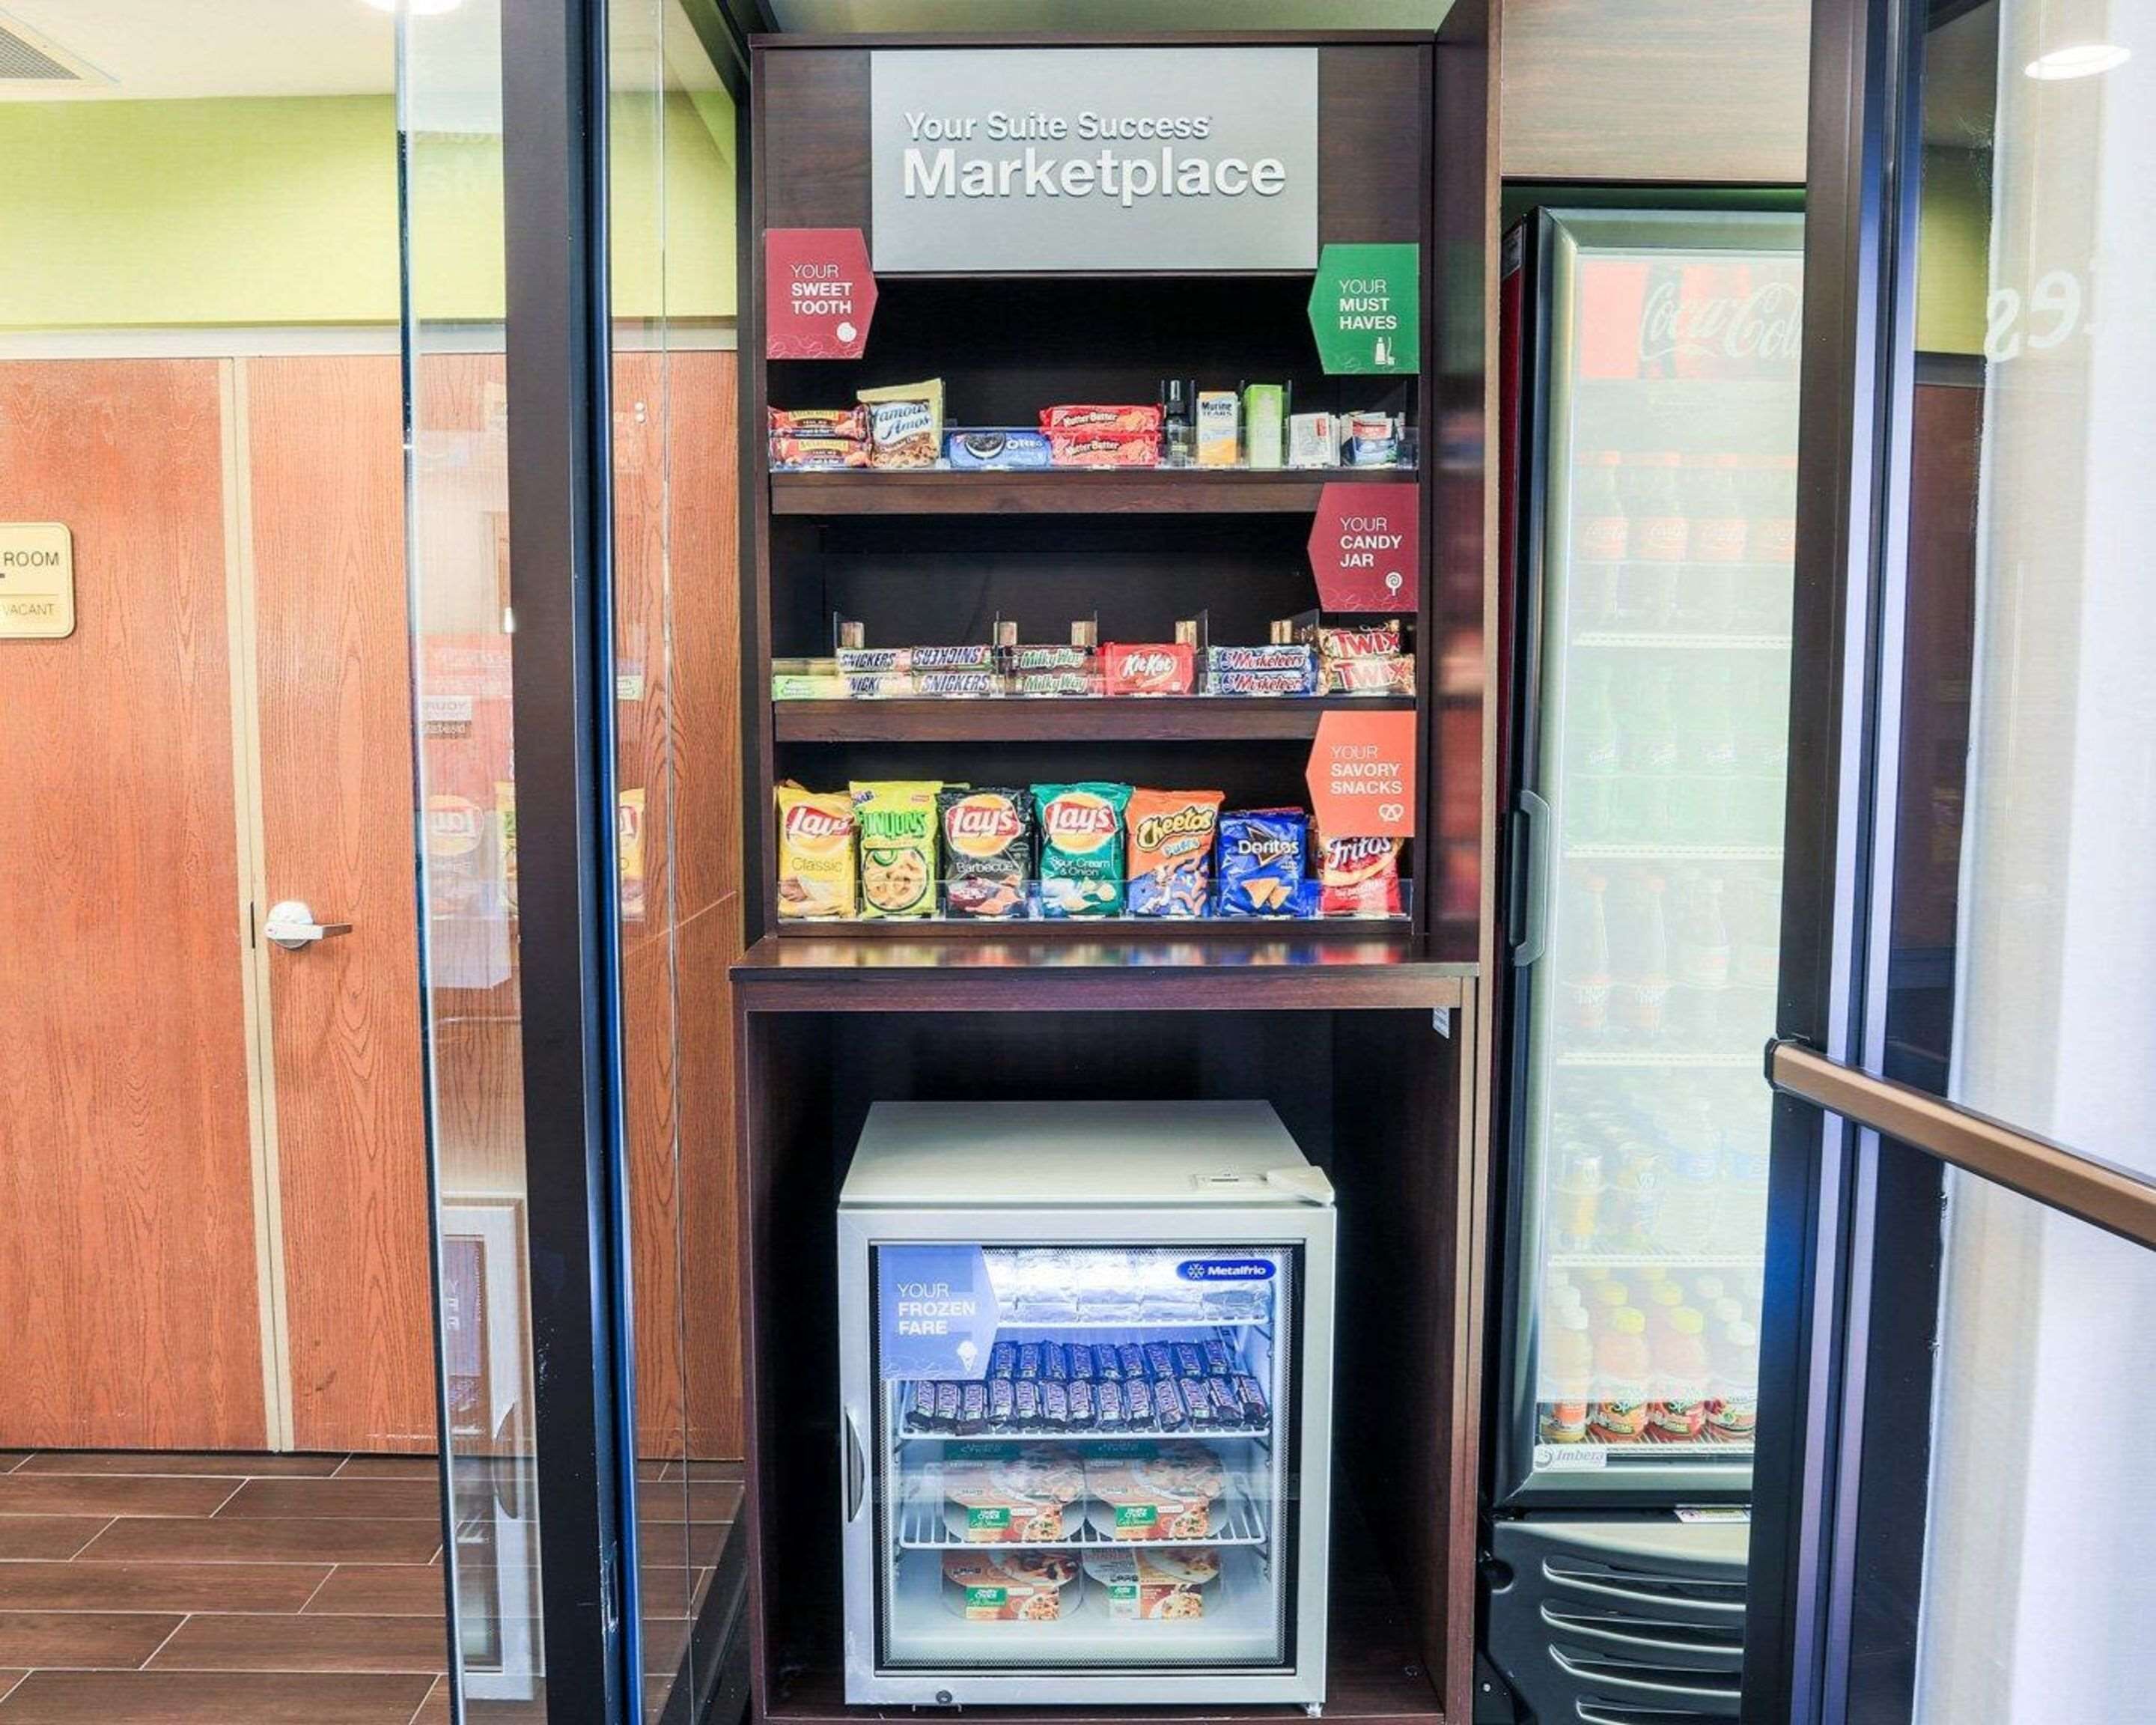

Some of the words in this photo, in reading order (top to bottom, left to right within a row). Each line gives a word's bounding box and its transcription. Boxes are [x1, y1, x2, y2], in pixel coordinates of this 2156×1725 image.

[904, 112, 977, 141] Your
[987, 111, 1068, 140] Suite
[1077, 112, 1211, 140] Success
[903, 147, 1287, 208] Marketplace
[790, 264, 839, 279] YOUR
[791, 282, 853, 296] SWEET
[1339, 279, 1387, 294] YOUR
[791, 299, 852, 315] TOOTH
[1339, 297, 1390, 312] MUST
[1339, 315, 1398, 330] HAVES
[871, 401, 931, 425] Famous
[1202, 401, 1232, 411] Murine
[882, 416, 931, 439] Amos
[1339, 517, 1387, 532] YOUR
[1339, 535, 1403, 550] CANDY
[3, 550, 60, 567] ROOM
[1339, 553, 1374, 568] JAR
[841, 652, 898, 668] SNICKERS
[914, 646, 981, 666] SNICKERS
[921, 675, 990, 691] SNICKERS
[1331, 746, 1378, 758] YOUR
[1331, 763, 1401, 777] SAVORY
[1330, 781, 1404, 795] SNACKS
[1136, 806, 1215, 849] Cheetos
[1237, 839, 1300, 855] Doritos
[1326, 836, 1392, 869] Fritos
[791, 857, 844, 873] Classic
[956, 861, 1014, 873] Barbecue
[1050, 857, 1074, 870] Sour
[1076, 858, 1111, 868] Cream
[1068, 866, 1100, 877] Onion
[1208, 1265, 1267, 1276] Metalfrio
[896, 1283, 950, 1297] YOUR
[898, 1301, 976, 1317] FROZEN
[898, 1320, 948, 1336] FARE
